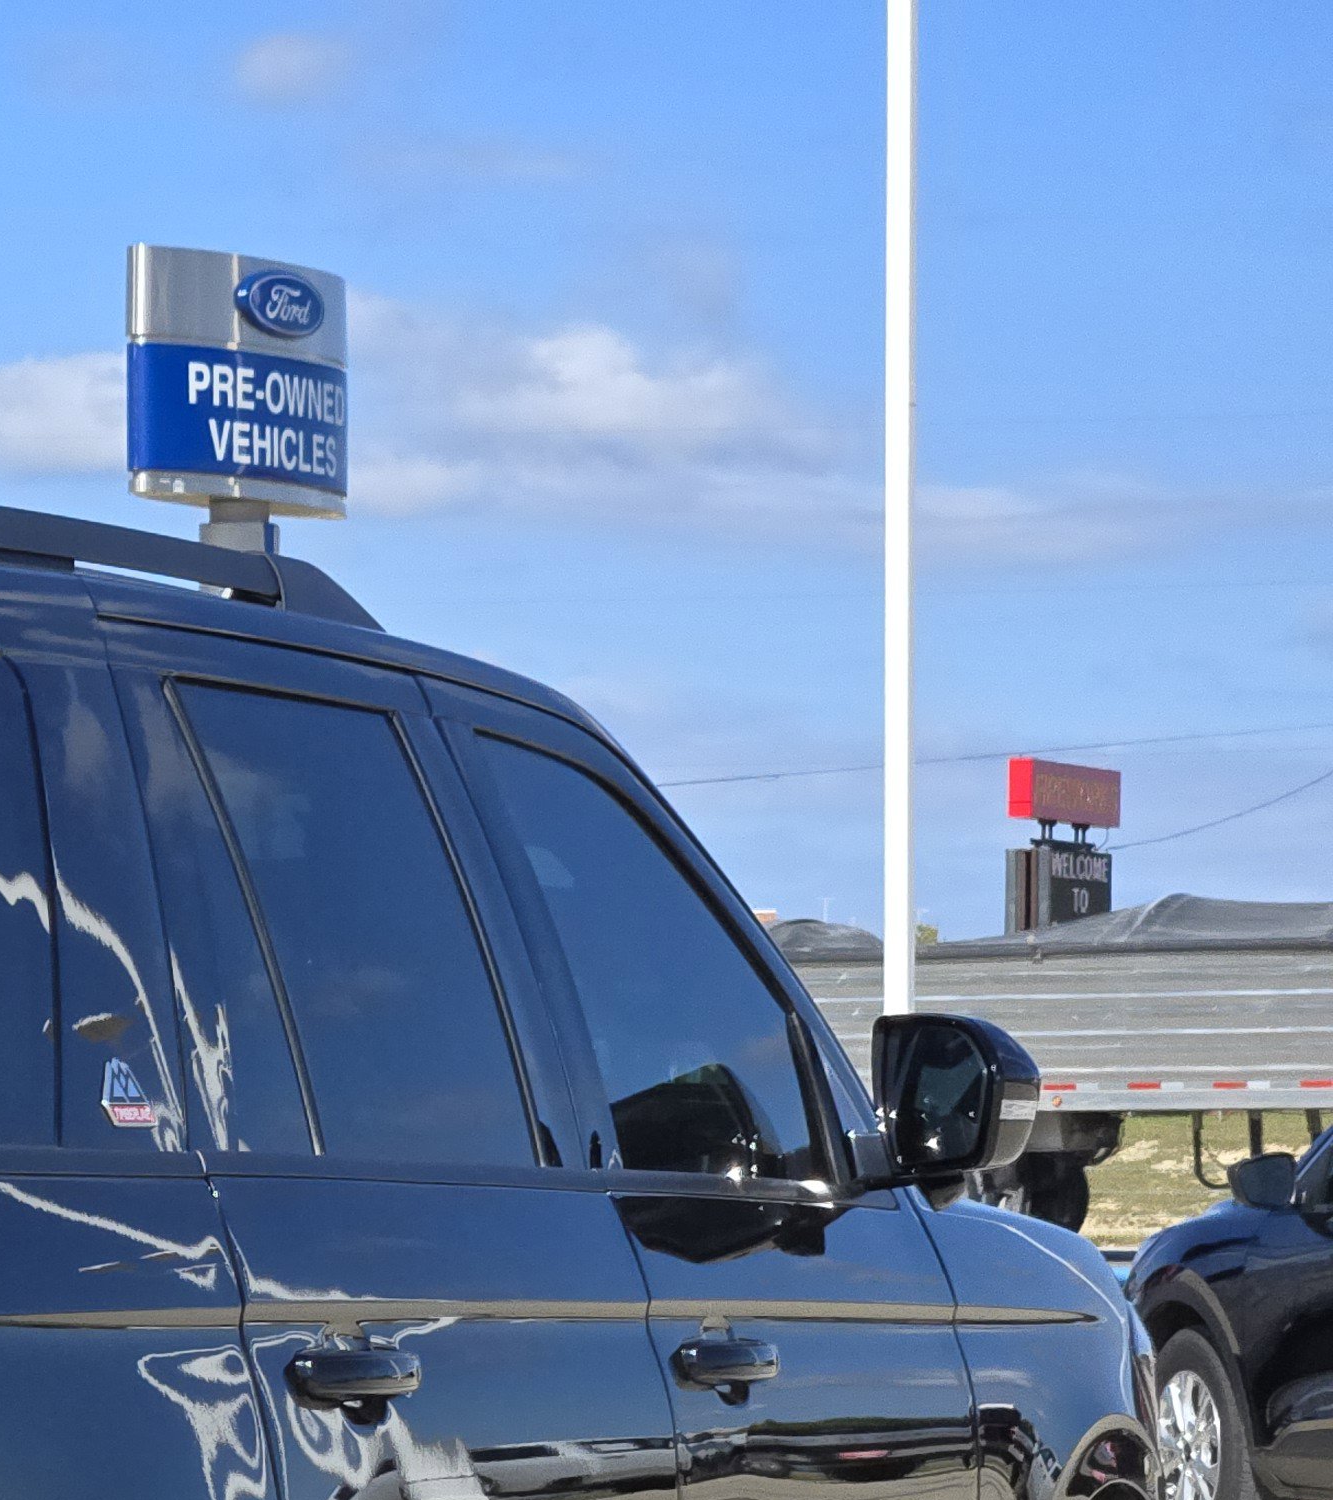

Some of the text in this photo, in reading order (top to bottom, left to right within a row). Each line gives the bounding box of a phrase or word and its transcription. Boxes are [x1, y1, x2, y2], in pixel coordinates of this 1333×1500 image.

[265, 284, 311, 325] Ford
[188, 361, 345, 427] PRE-OWNED
[208, 418, 337, 477] VEHICLES
[1052, 851, 1108, 883] WELCOME
[1072, 887, 1089, 913] TO
